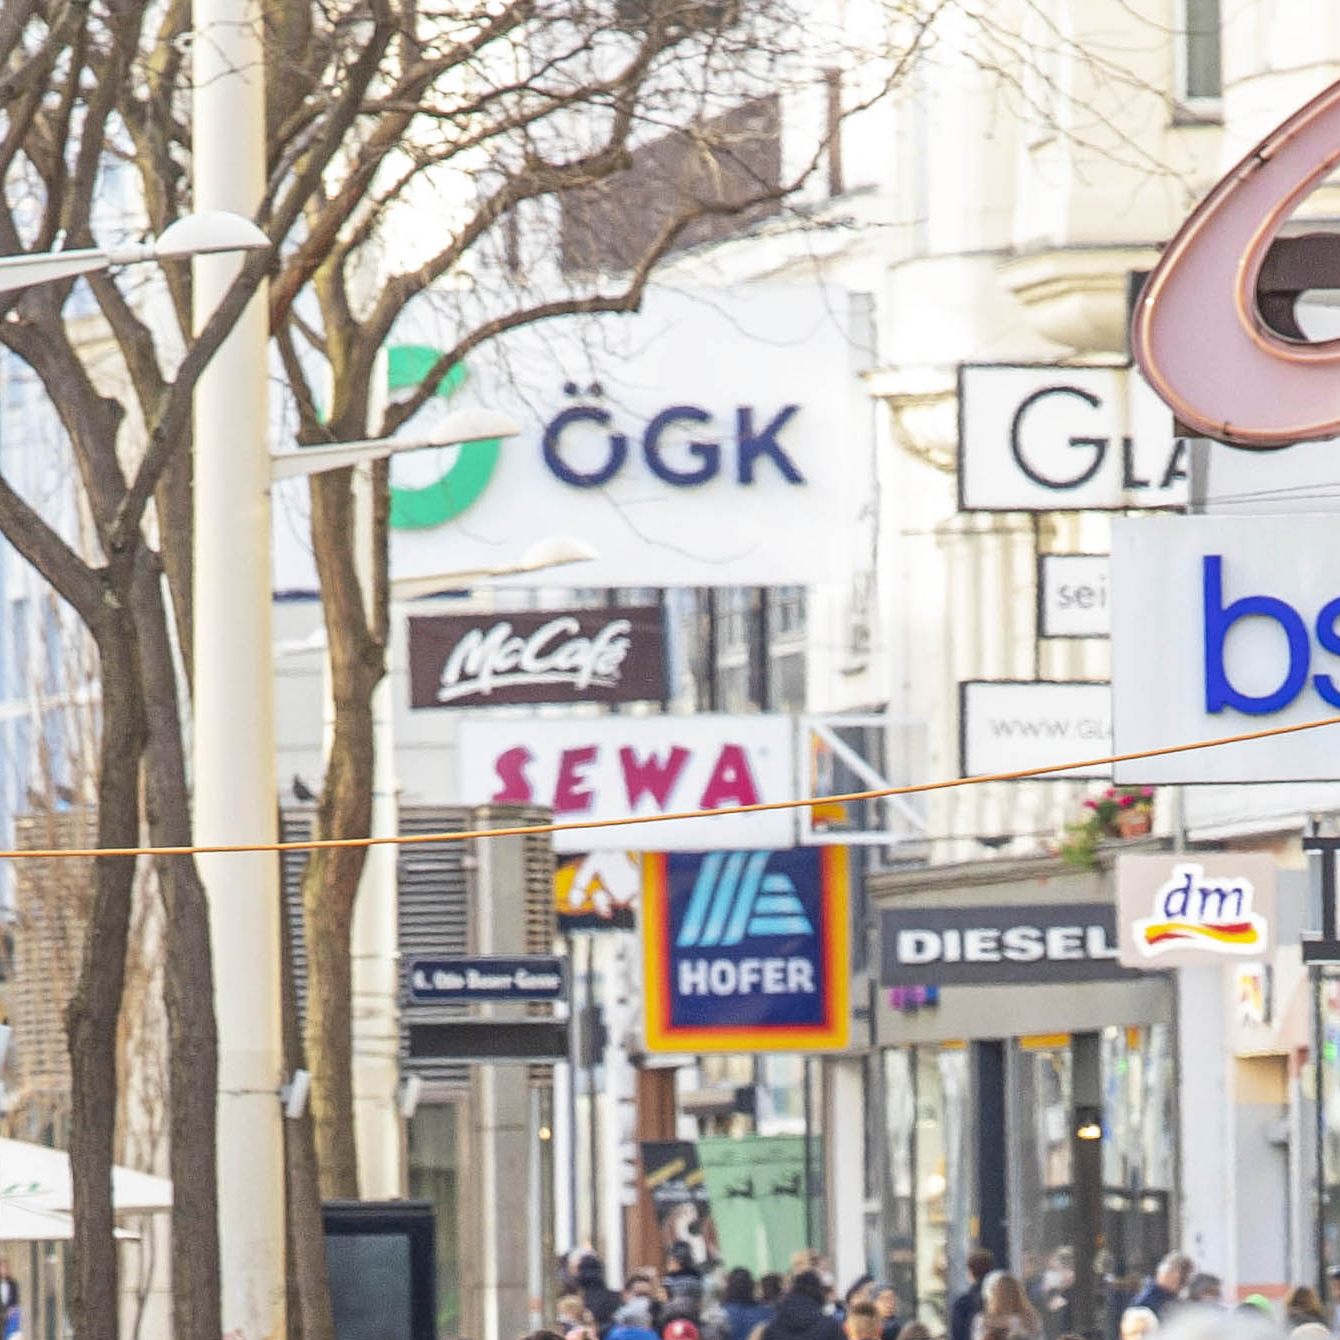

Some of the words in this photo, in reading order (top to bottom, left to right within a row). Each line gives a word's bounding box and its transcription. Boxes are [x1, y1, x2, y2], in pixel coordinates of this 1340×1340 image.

[541, 381, 806, 487] ÖGK
[440, 615, 632, 696] McCafé
[492, 743, 764, 812] SEWA
[1163, 872, 1245, 920] dm
[896, 925, 1121, 965] DIESEL
[678, 957, 816, 996] HOFER
